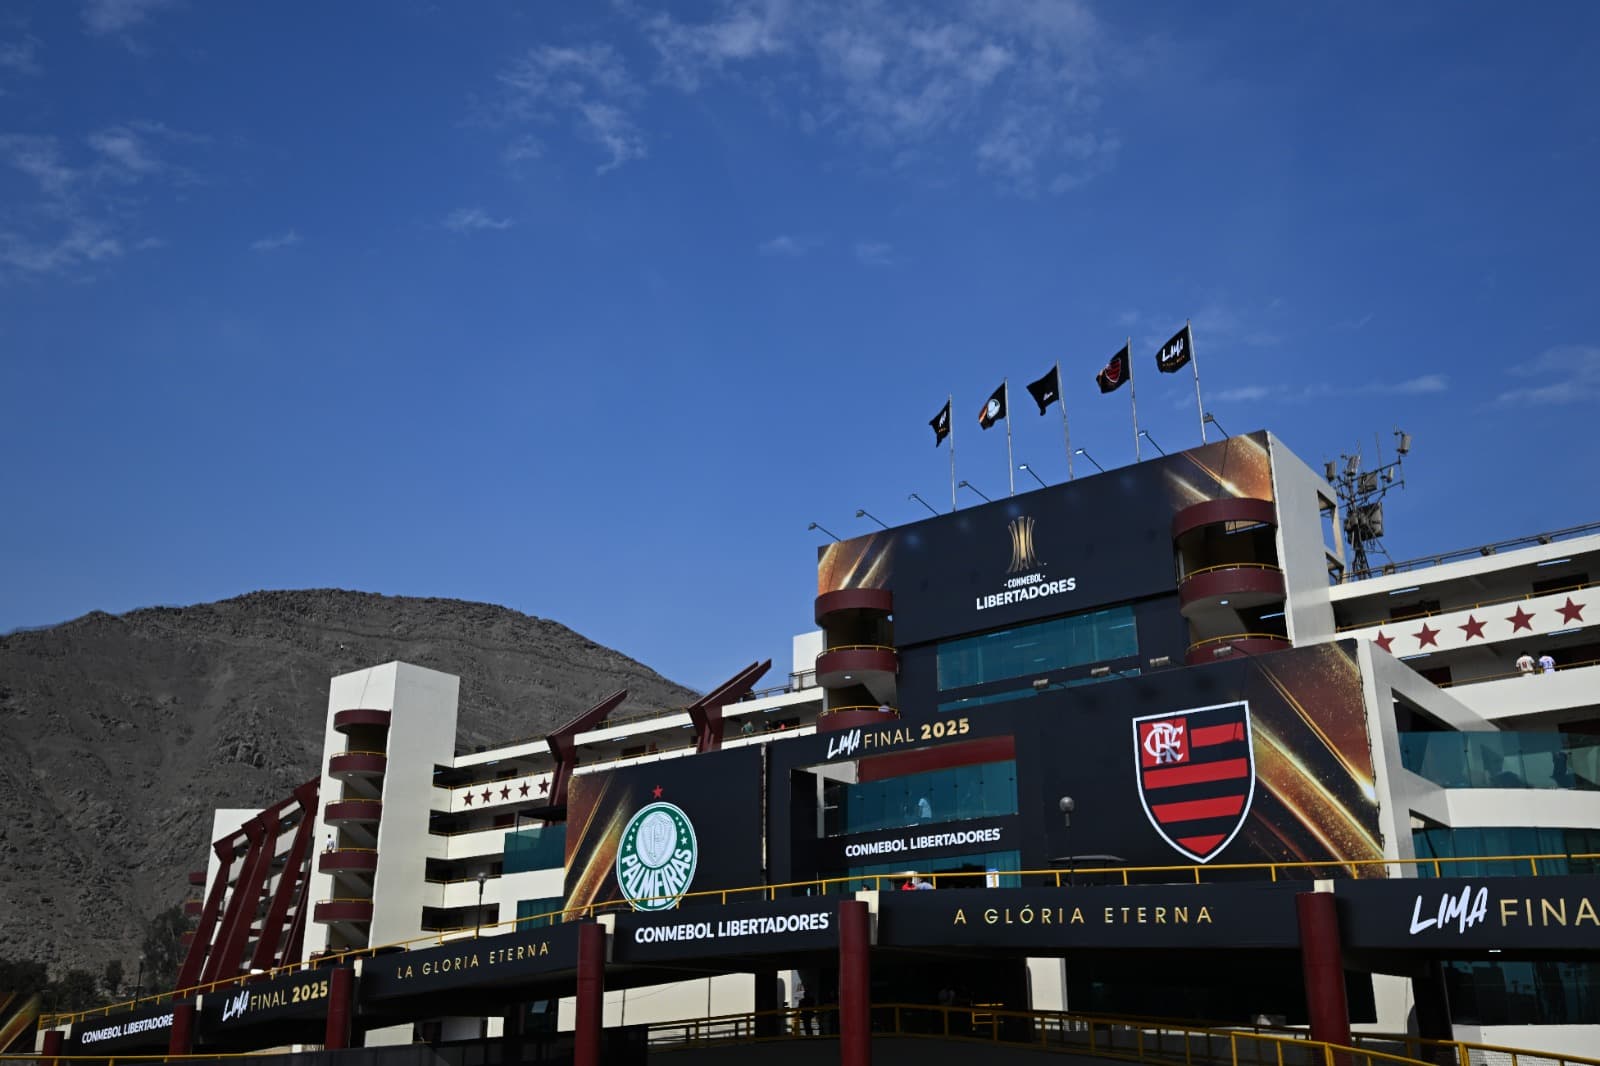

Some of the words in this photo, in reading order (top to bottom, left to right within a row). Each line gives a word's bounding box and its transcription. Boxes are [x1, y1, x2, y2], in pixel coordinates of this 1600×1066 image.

[976, 577, 1076, 610] LIBERTADORES
[827, 729, 861, 759] LIMA
[864, 727, 915, 749] FINAL
[920, 718, 970, 740] 2025
[845, 838, 908, 857] CONMEBOL
[910, 828, 1001, 850] LIBERTADORES
[621, 848, 692, 907] PALMEIRAS
[635, 922, 715, 943] CONMEBOL
[718, 912, 829, 937] LIBERTADORES
[953, 908, 968, 925] A
[984, 904, 1085, 925] GLÓRIA
[1104, 906, 1212, 925] ETERNA
[1409, 885, 1489, 935] LIMA
[1499, 898, 1600, 927] FINA
[397, 965, 414, 979] LA
[422, 954, 479, 976] GLORIA
[489, 941, 549, 964] ETERNA
[222, 990, 250, 1022] LIMA
[250, 989, 288, 1011] FINAL
[292, 980, 328, 1003] 2025
[81, 1025, 122, 1044] CONMEBOL
[123, 1013, 174, 1035] LIBERTADORE
